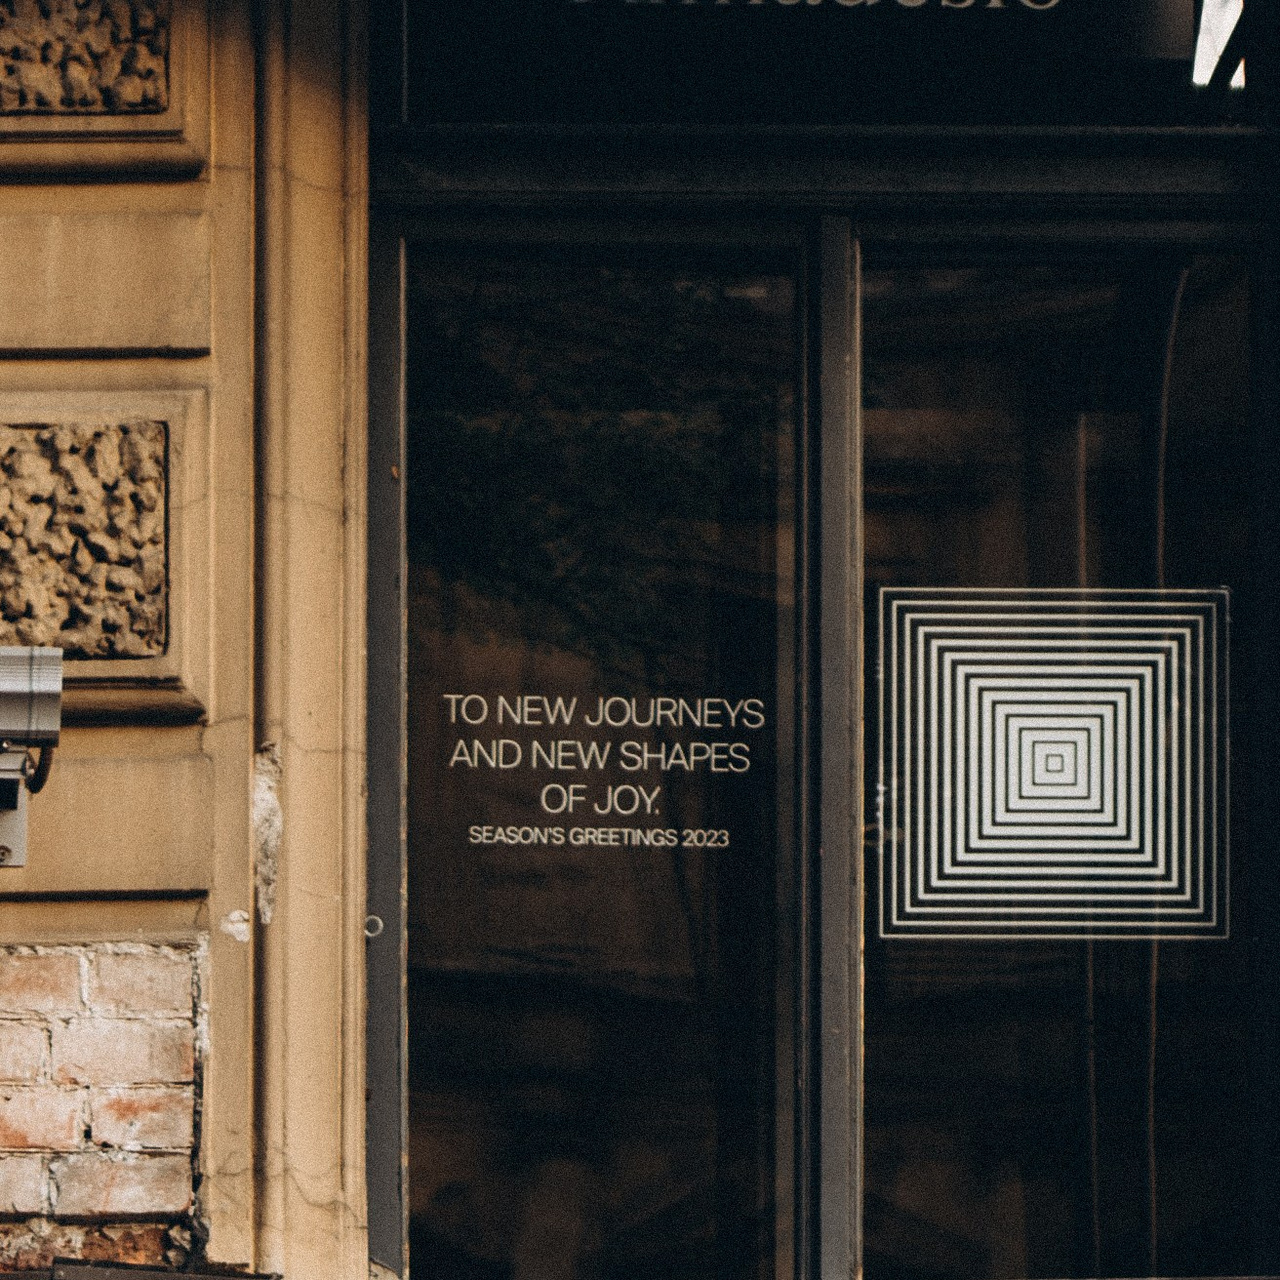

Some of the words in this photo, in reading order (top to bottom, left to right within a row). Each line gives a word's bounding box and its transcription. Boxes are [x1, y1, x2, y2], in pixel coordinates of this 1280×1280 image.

[443, 694, 488, 725] TO
[497, 695, 577, 725] NEW
[584, 696, 765, 728] JOURNEYS
[450, 739, 522, 769] AND
[531, 740, 611, 770] NEW
[620, 741, 750, 772] SHAPES
[540, 783, 587, 814] OF
[593, 784, 661, 815] JOY.
[469, 825, 565, 845] SEASON'S
[569, 827, 678, 847] GREETINGS
[682, 829, 729, 847] 2023
